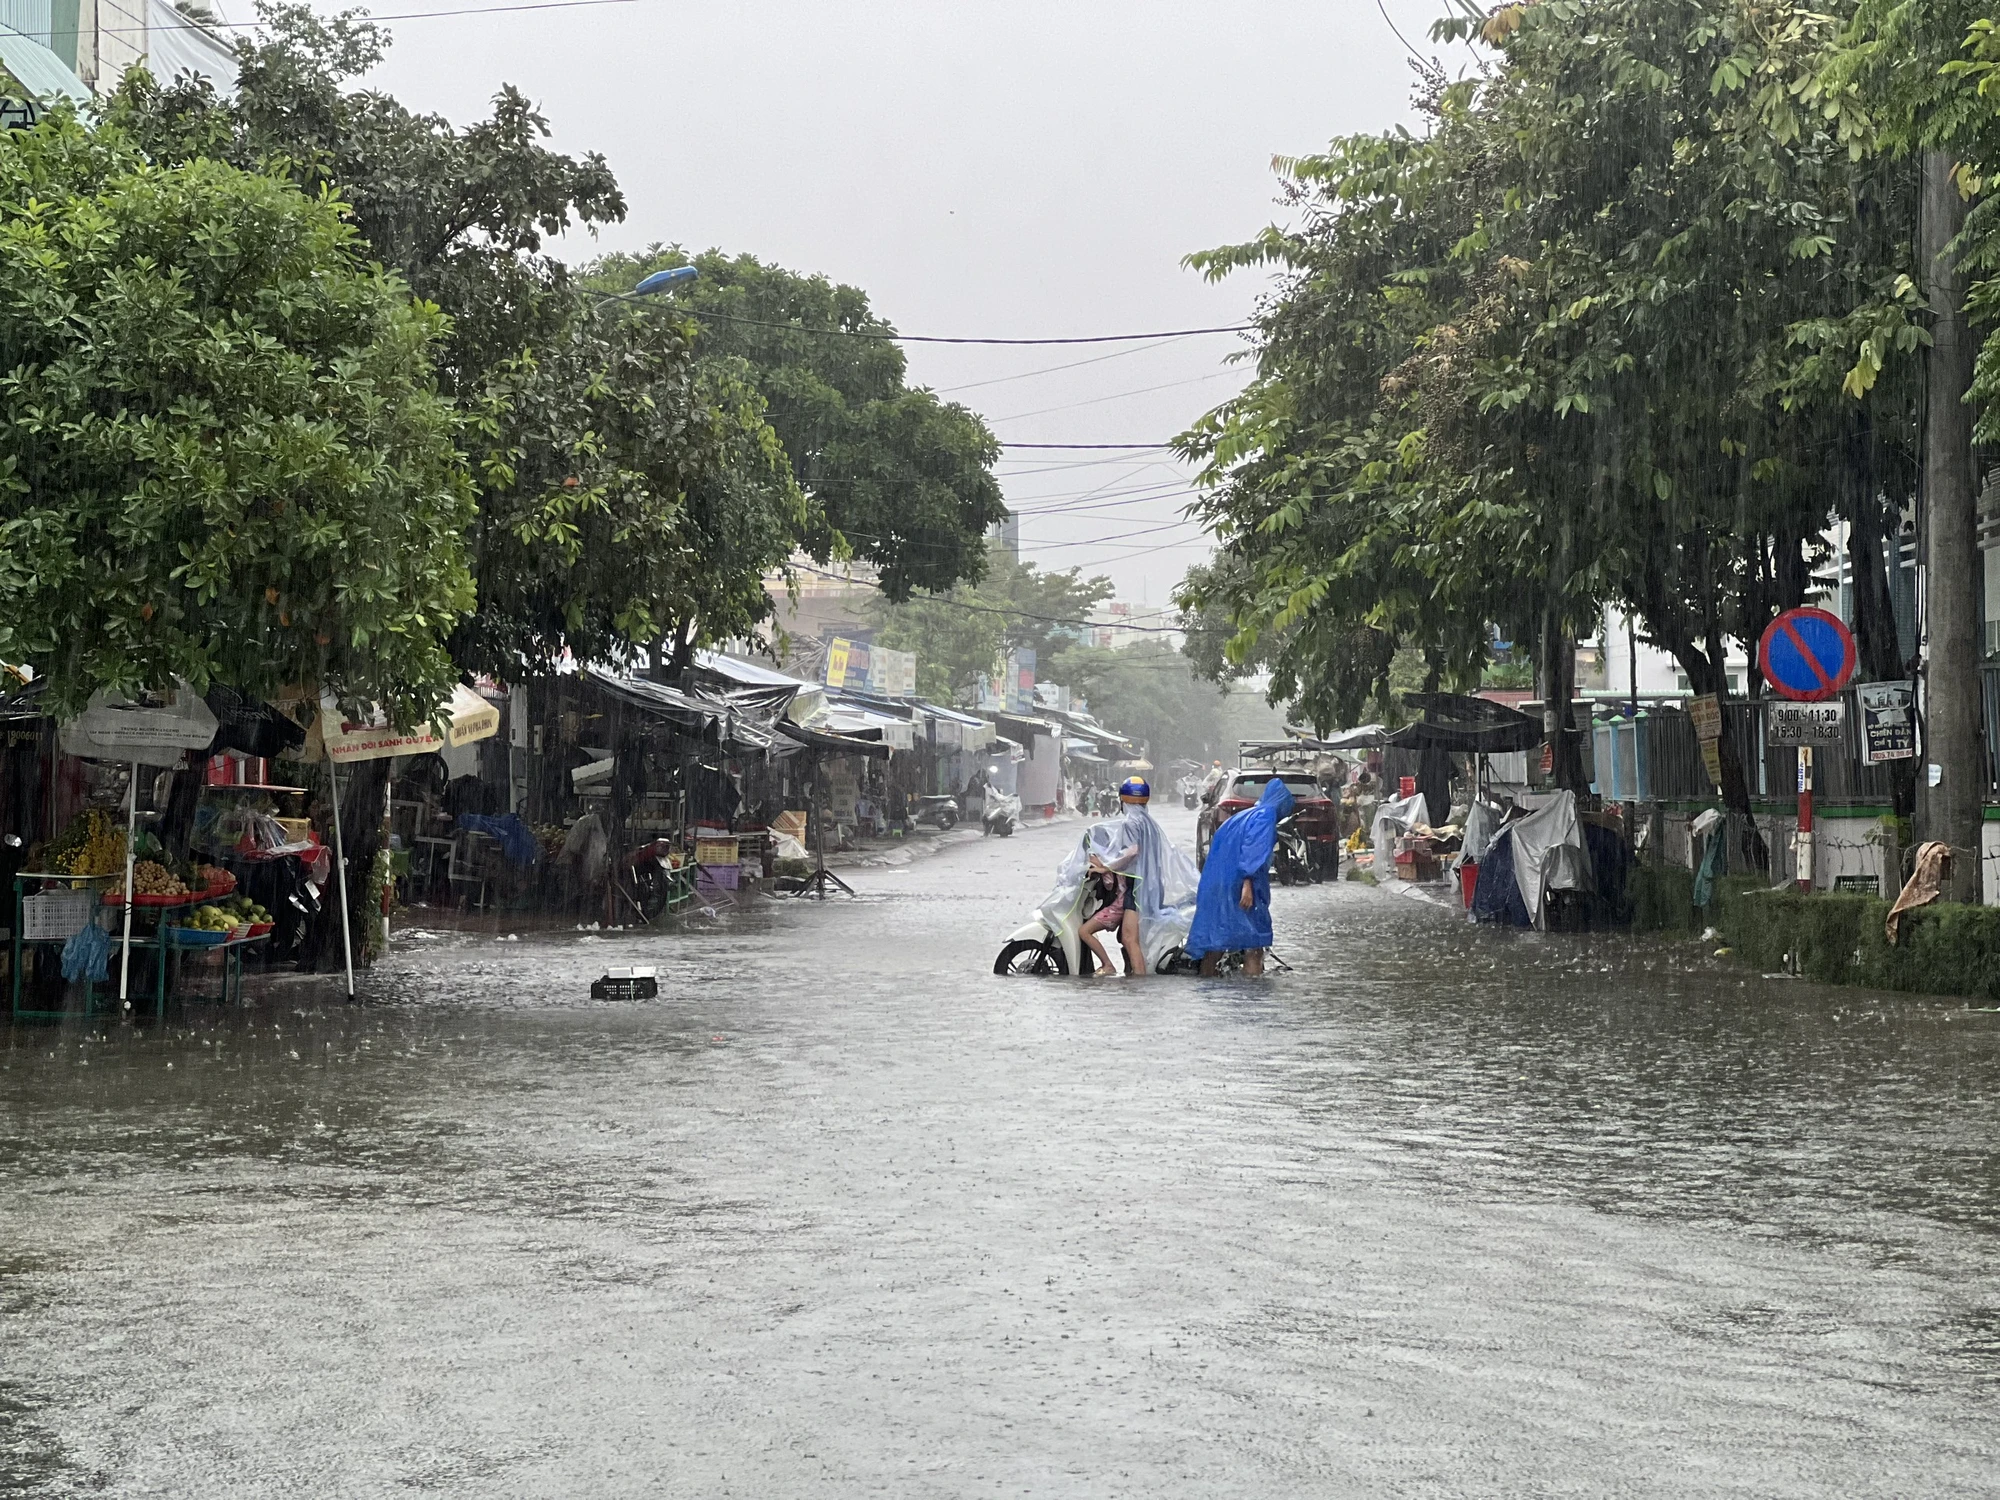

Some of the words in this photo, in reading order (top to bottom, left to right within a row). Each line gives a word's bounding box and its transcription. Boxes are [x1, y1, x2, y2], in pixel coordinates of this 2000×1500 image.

[1809, 709, 1837, 721] 11:30
[1775, 726, 1802, 738] 15:30
[1813, 726, 1839, 738] 18:30
[378, 736, 403, 748] SÁNH
[1886, 739, 1892, 749] 1
